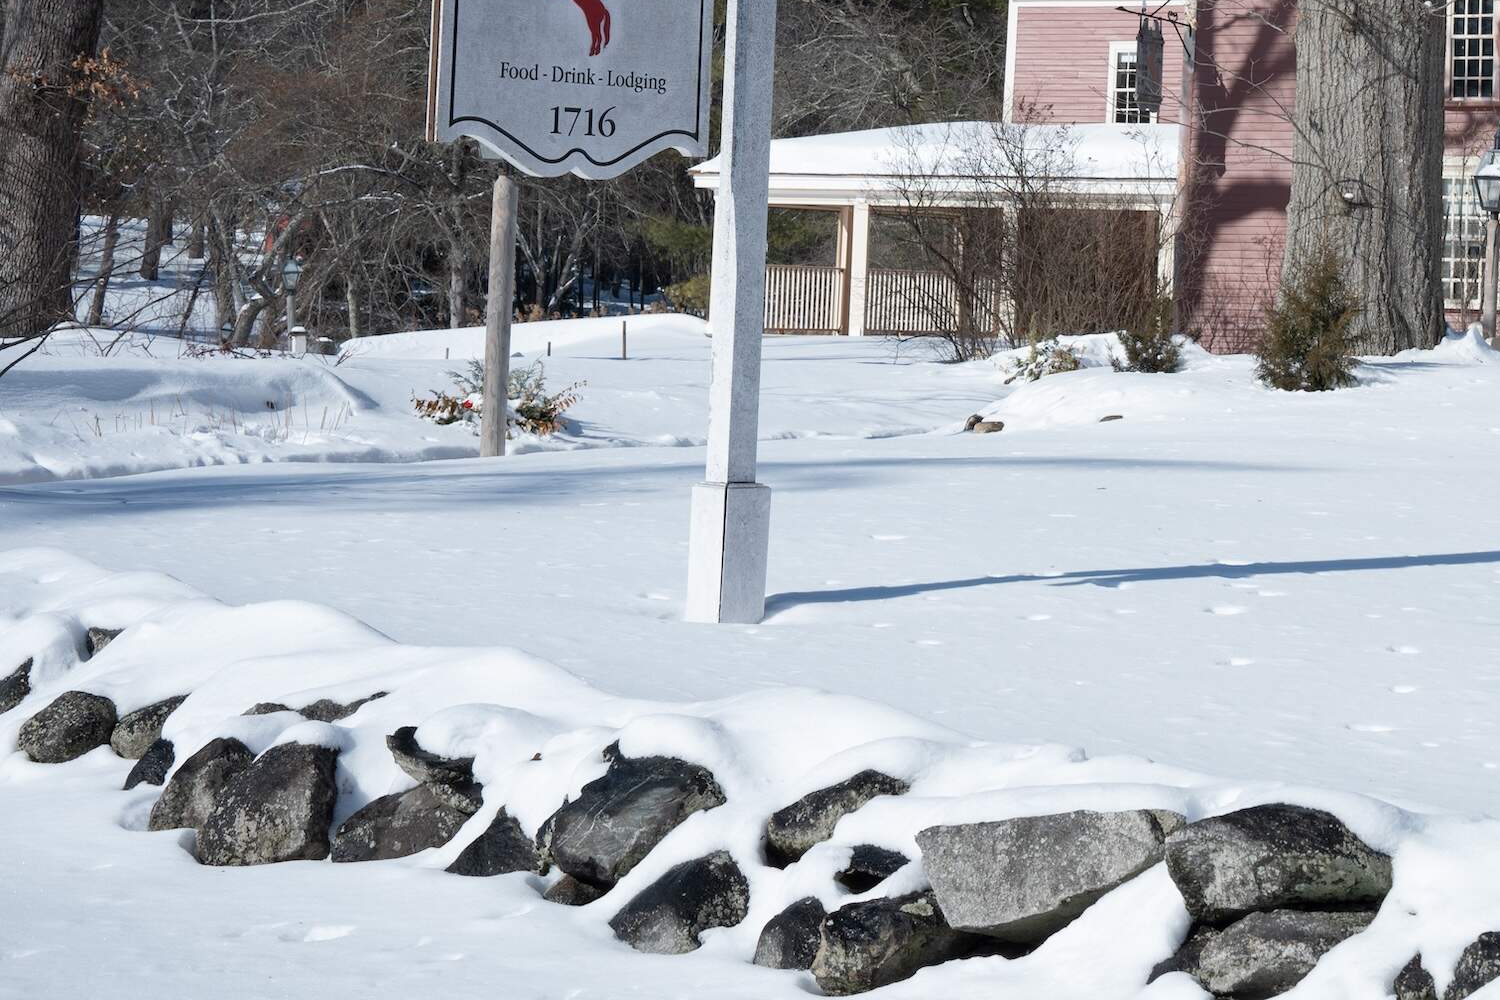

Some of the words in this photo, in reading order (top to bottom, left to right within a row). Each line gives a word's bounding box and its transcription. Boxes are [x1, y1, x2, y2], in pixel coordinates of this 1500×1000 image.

[500, 61, 539, 86] Food
[551, 66, 596, 86] Drink
[607, 70, 667, 95] Lodging
[549, 106, 616, 137] 1716
